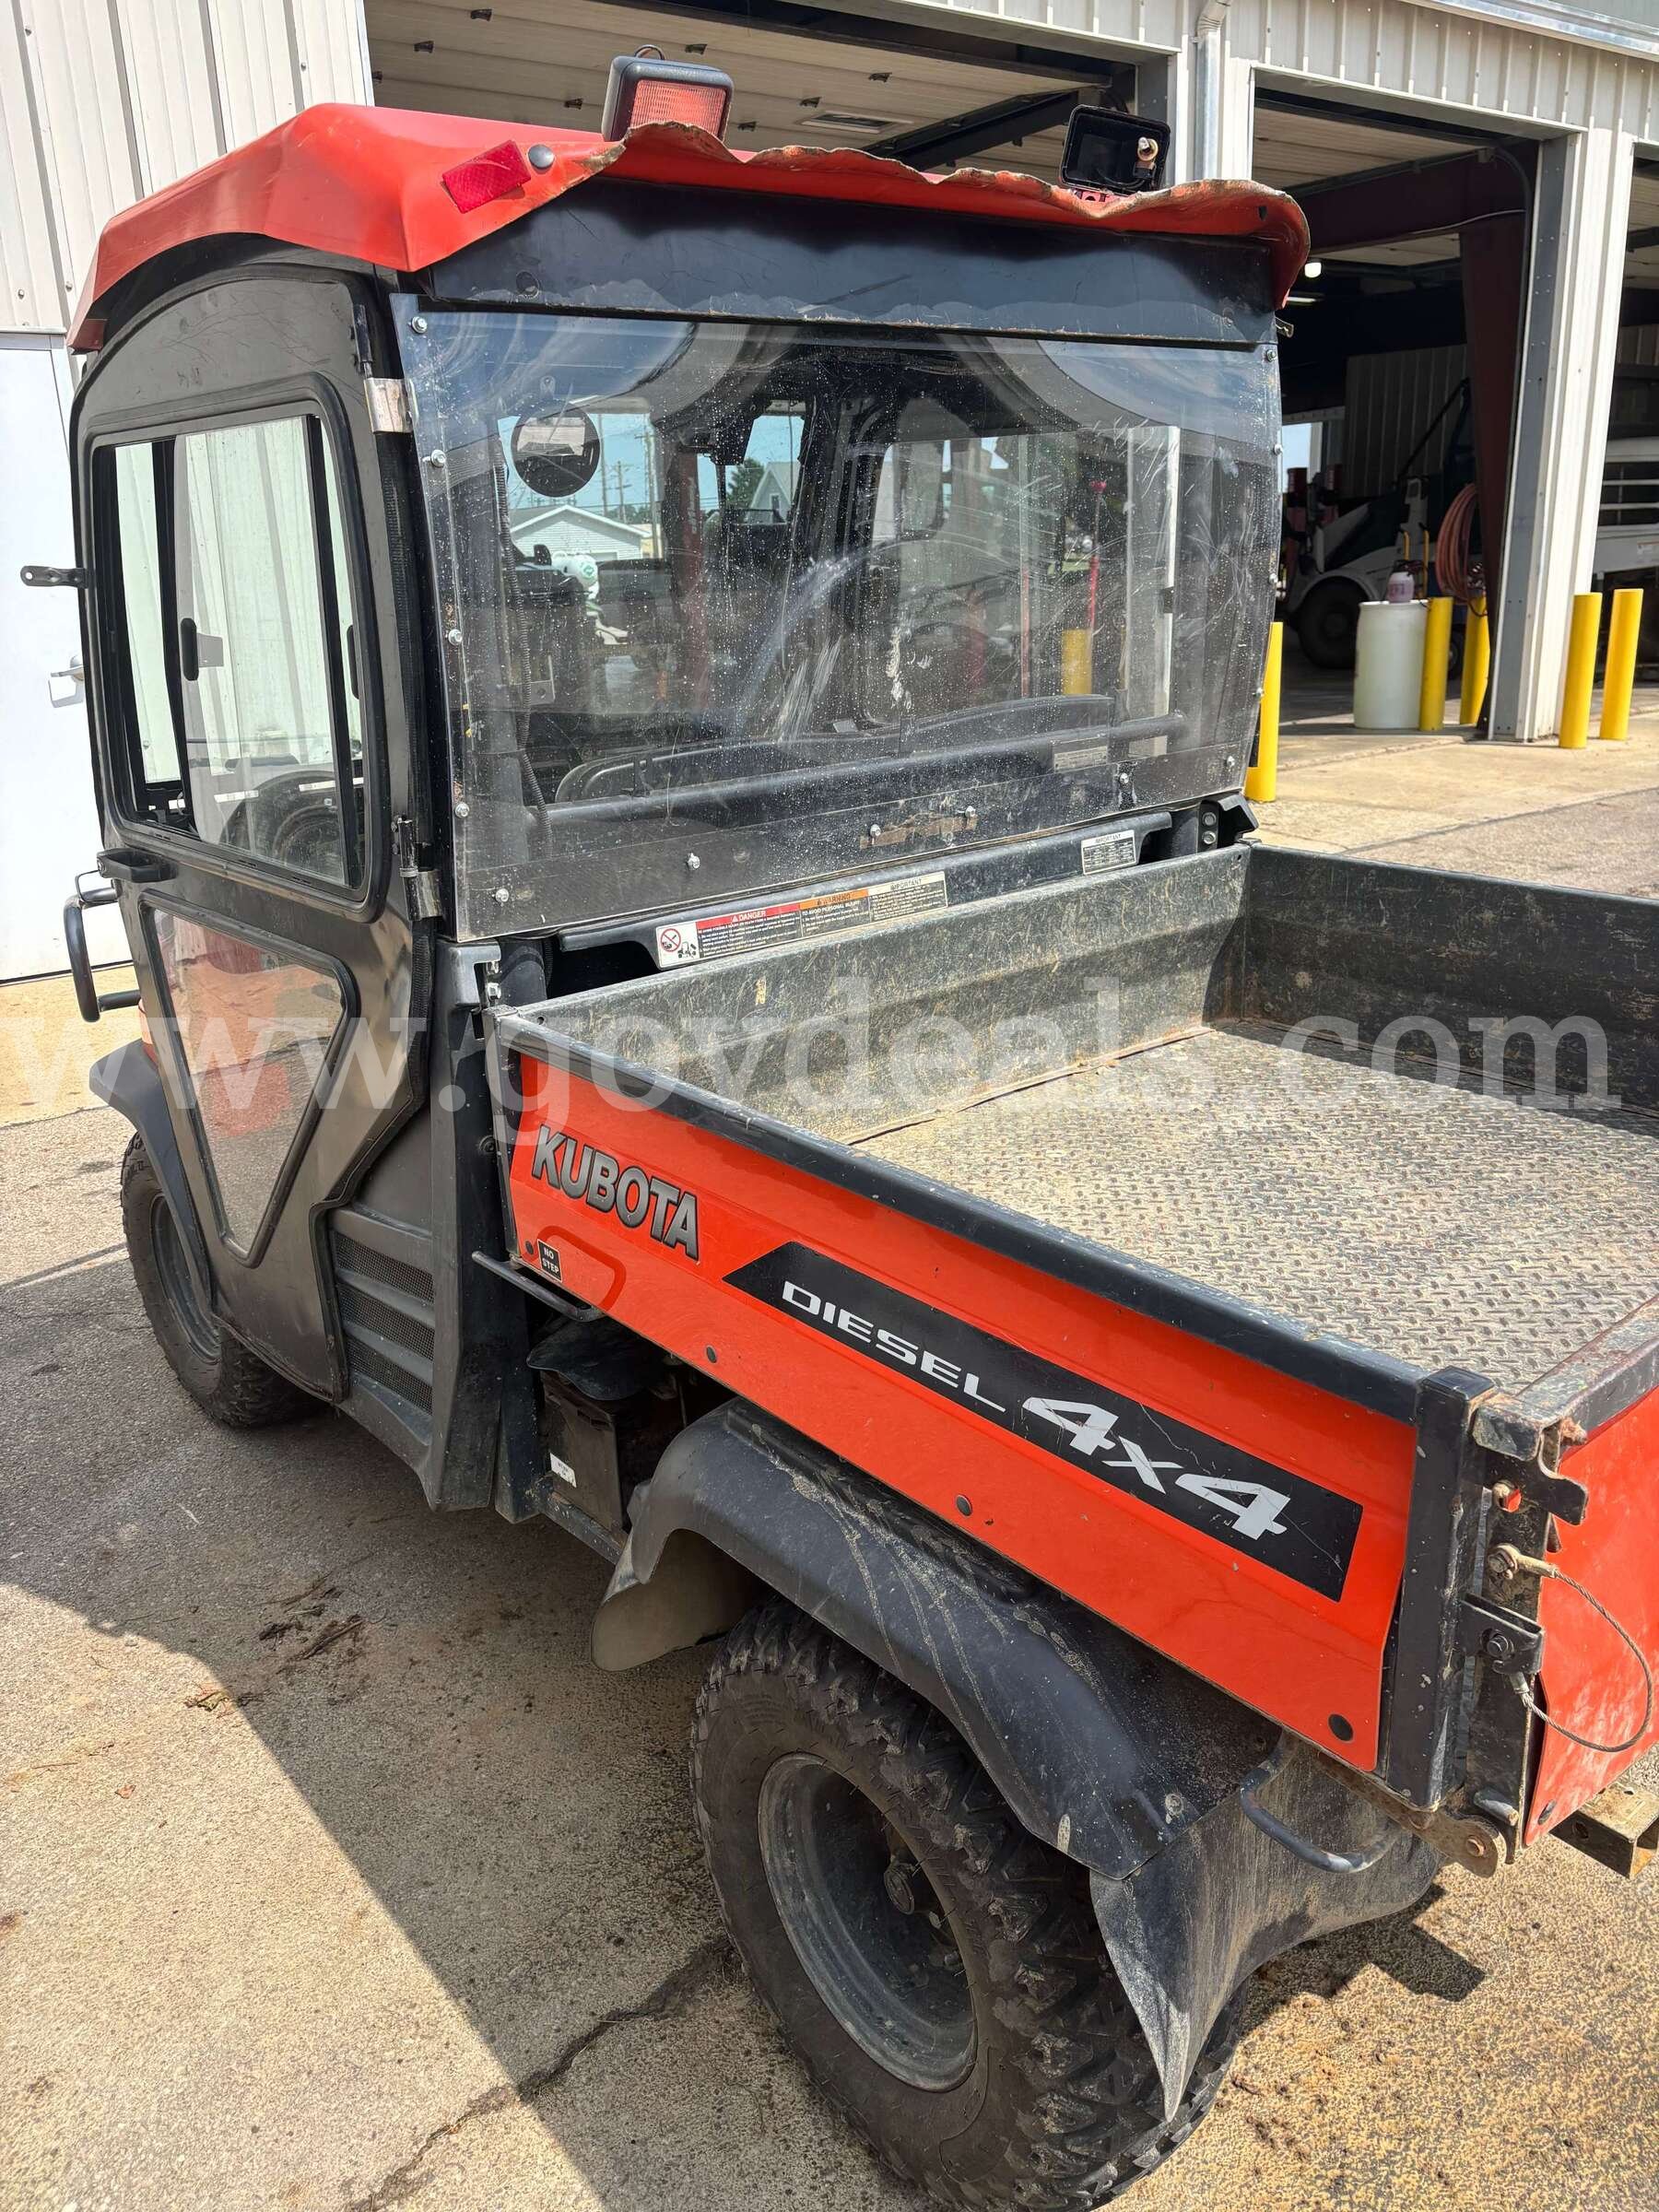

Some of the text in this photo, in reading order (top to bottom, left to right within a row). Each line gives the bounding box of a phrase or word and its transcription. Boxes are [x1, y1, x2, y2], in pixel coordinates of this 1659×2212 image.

[890, 878, 922, 890] IMPORTANT
[738, 910, 767, 922] DANGER
[532, 1124, 700, 1261] KUBOTA
[544, 1246, 555, 1260] NO
[542, 1257, 559, 1274] STEP
[782, 1280, 1006, 1413] DIESEL
